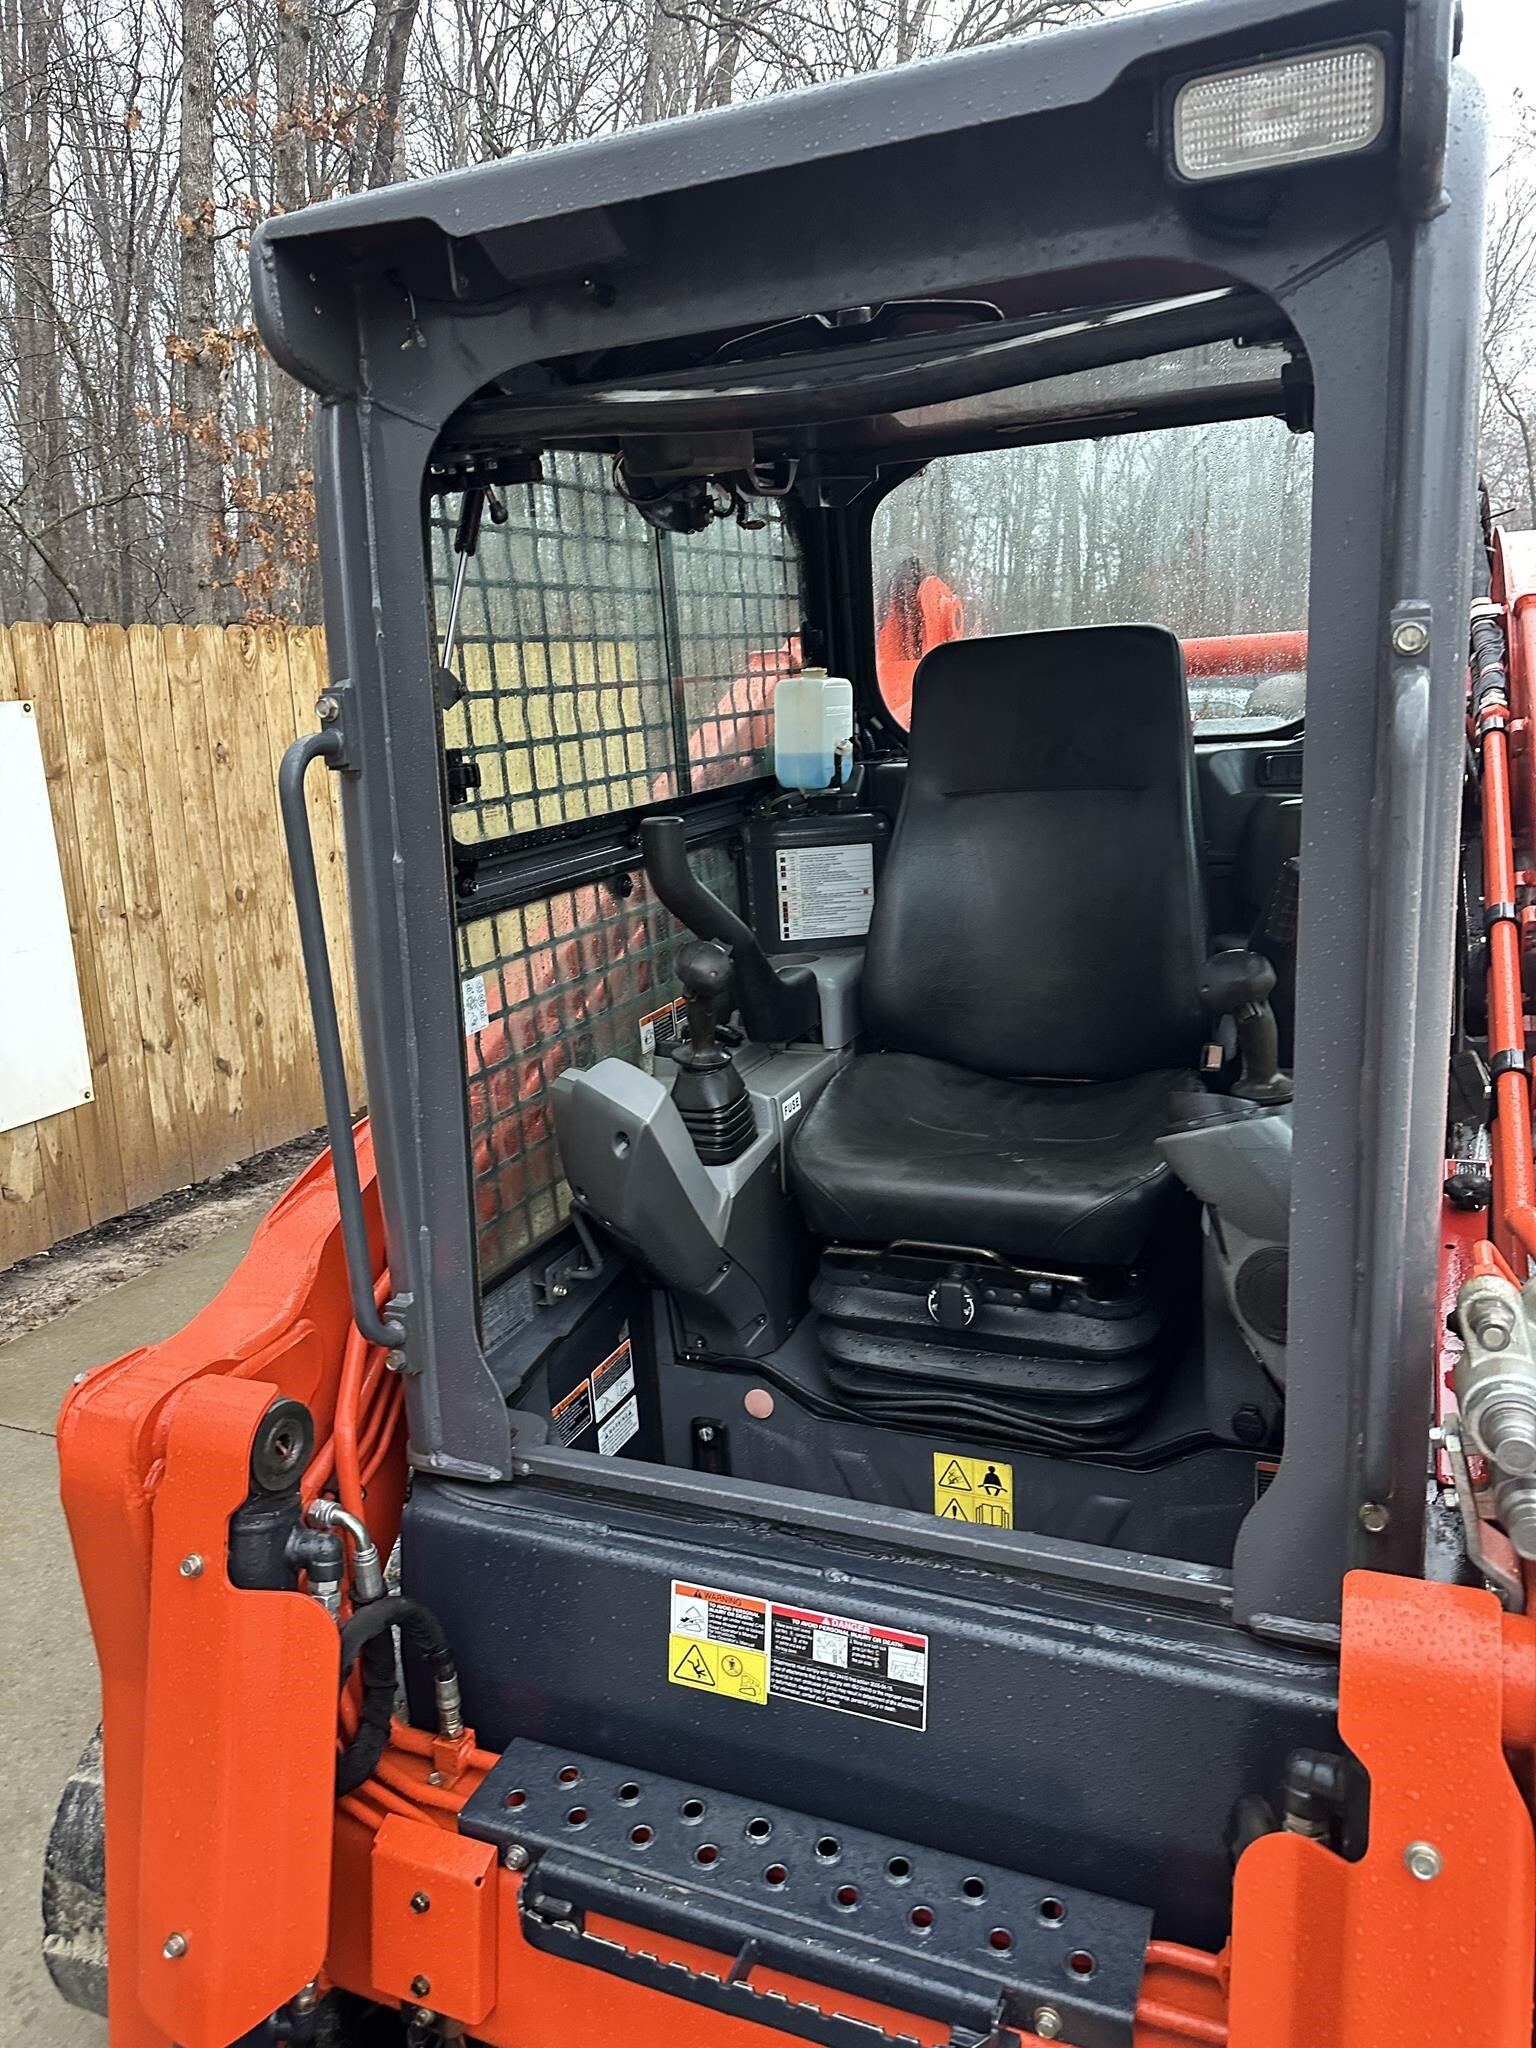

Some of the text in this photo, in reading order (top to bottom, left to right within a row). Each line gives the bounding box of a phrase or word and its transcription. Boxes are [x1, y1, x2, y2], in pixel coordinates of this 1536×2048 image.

[785, 1097, 799, 1116] FUSE
[704, 1591, 742, 1606] WARNING
[800, 1620, 818, 1629] AVOID
[818, 1625, 850, 1637] PERSONAL
[850, 1631, 872, 1642] INJURY
[872, 1636, 882, 1644] OR
[832, 1619, 870, 1635] DANGER
